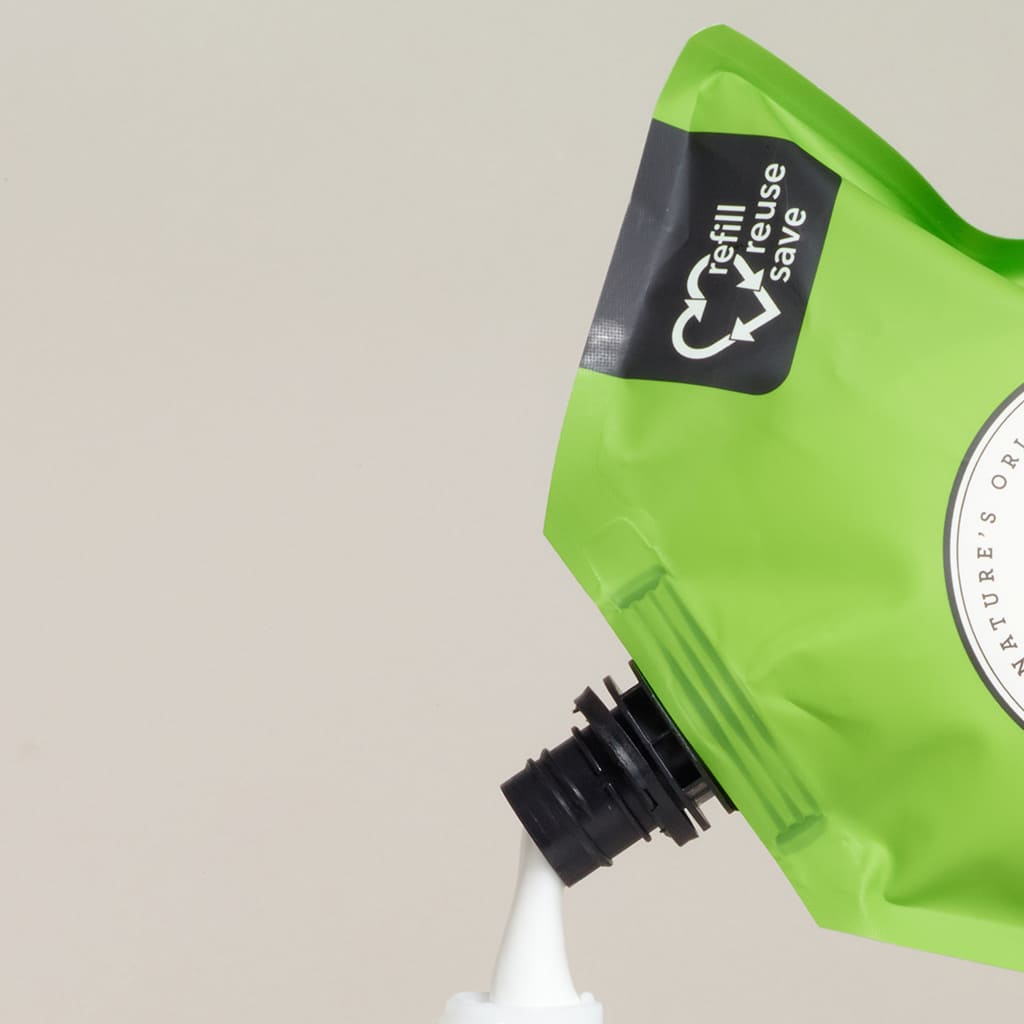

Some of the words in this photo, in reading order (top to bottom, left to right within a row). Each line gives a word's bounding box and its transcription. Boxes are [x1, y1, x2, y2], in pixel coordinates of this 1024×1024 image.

[709, 204, 747, 275] refill
[746, 163, 786, 253] reuse
[770, 207, 807, 283] save
